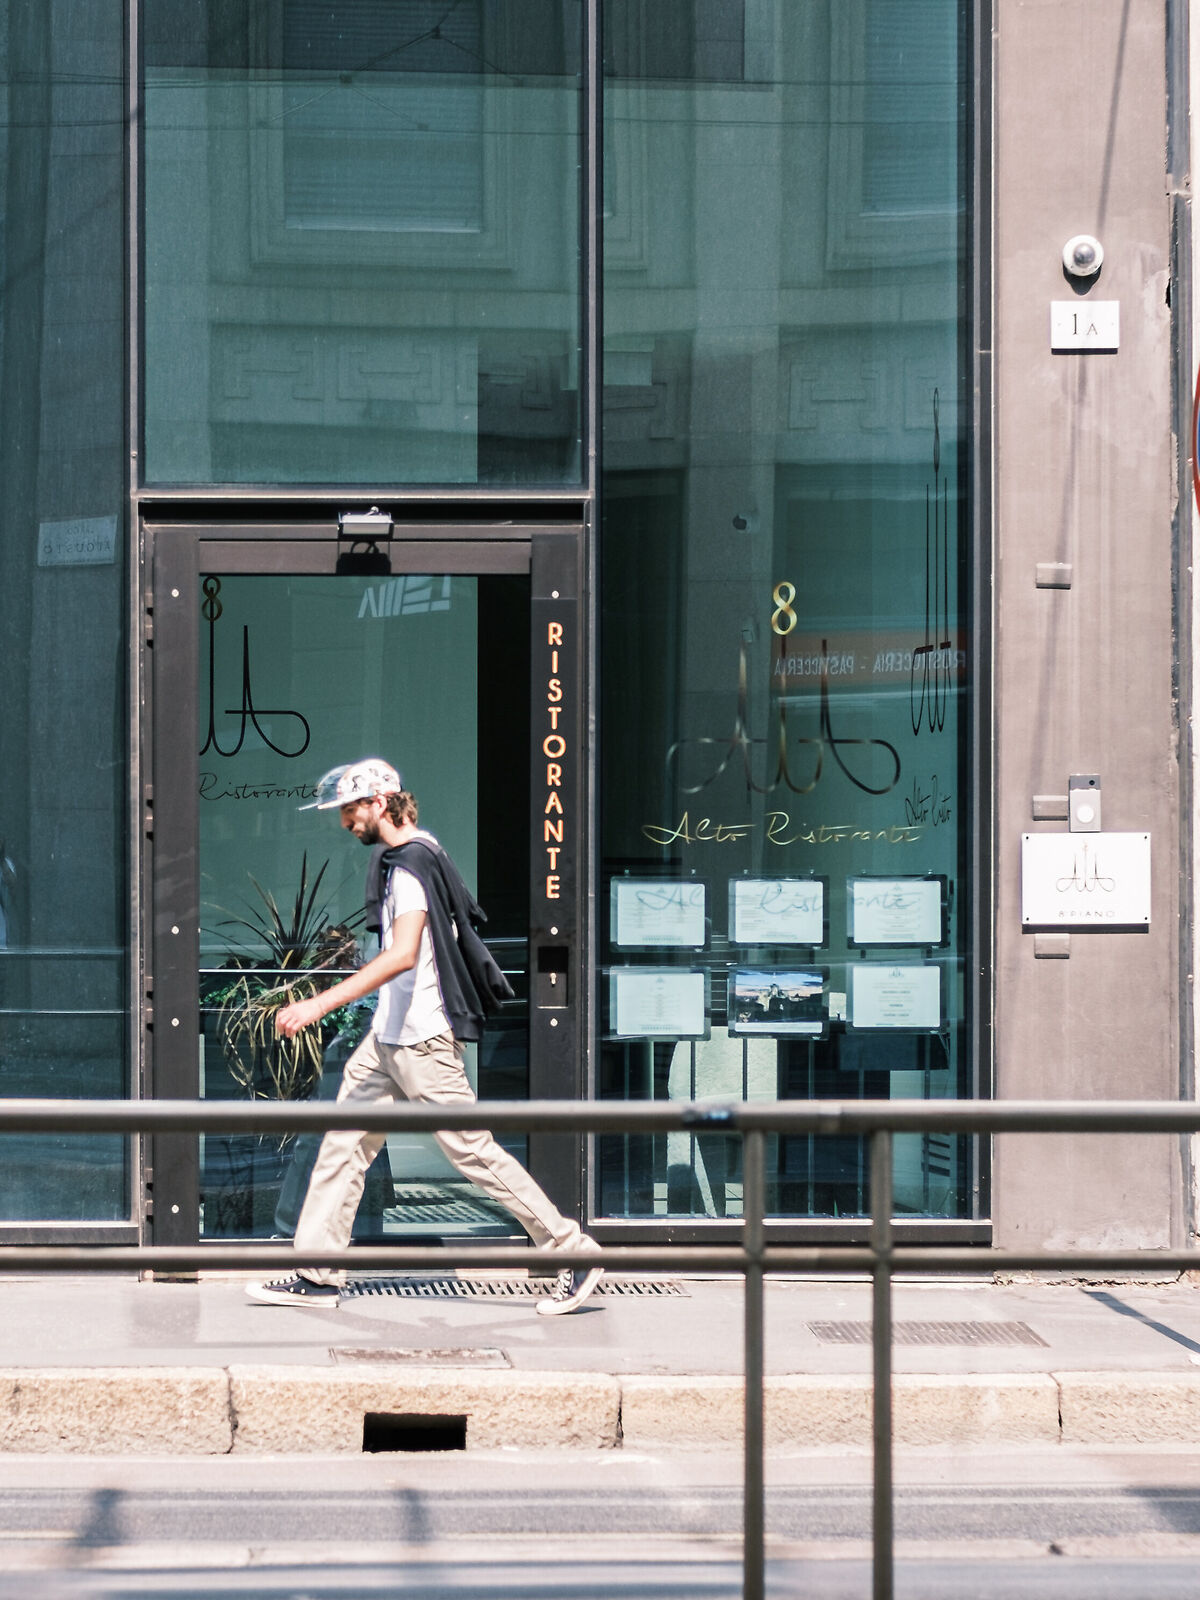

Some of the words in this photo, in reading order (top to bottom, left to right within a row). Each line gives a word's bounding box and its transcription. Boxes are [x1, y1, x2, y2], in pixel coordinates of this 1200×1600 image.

[771, 581, 798, 635] 8
[542, 620, 566, 899] RISTORANTE
[641, 811, 756, 846] Alto
[764, 811, 924, 846] Ristorante
[1070, 910, 1116, 918] PIANO
